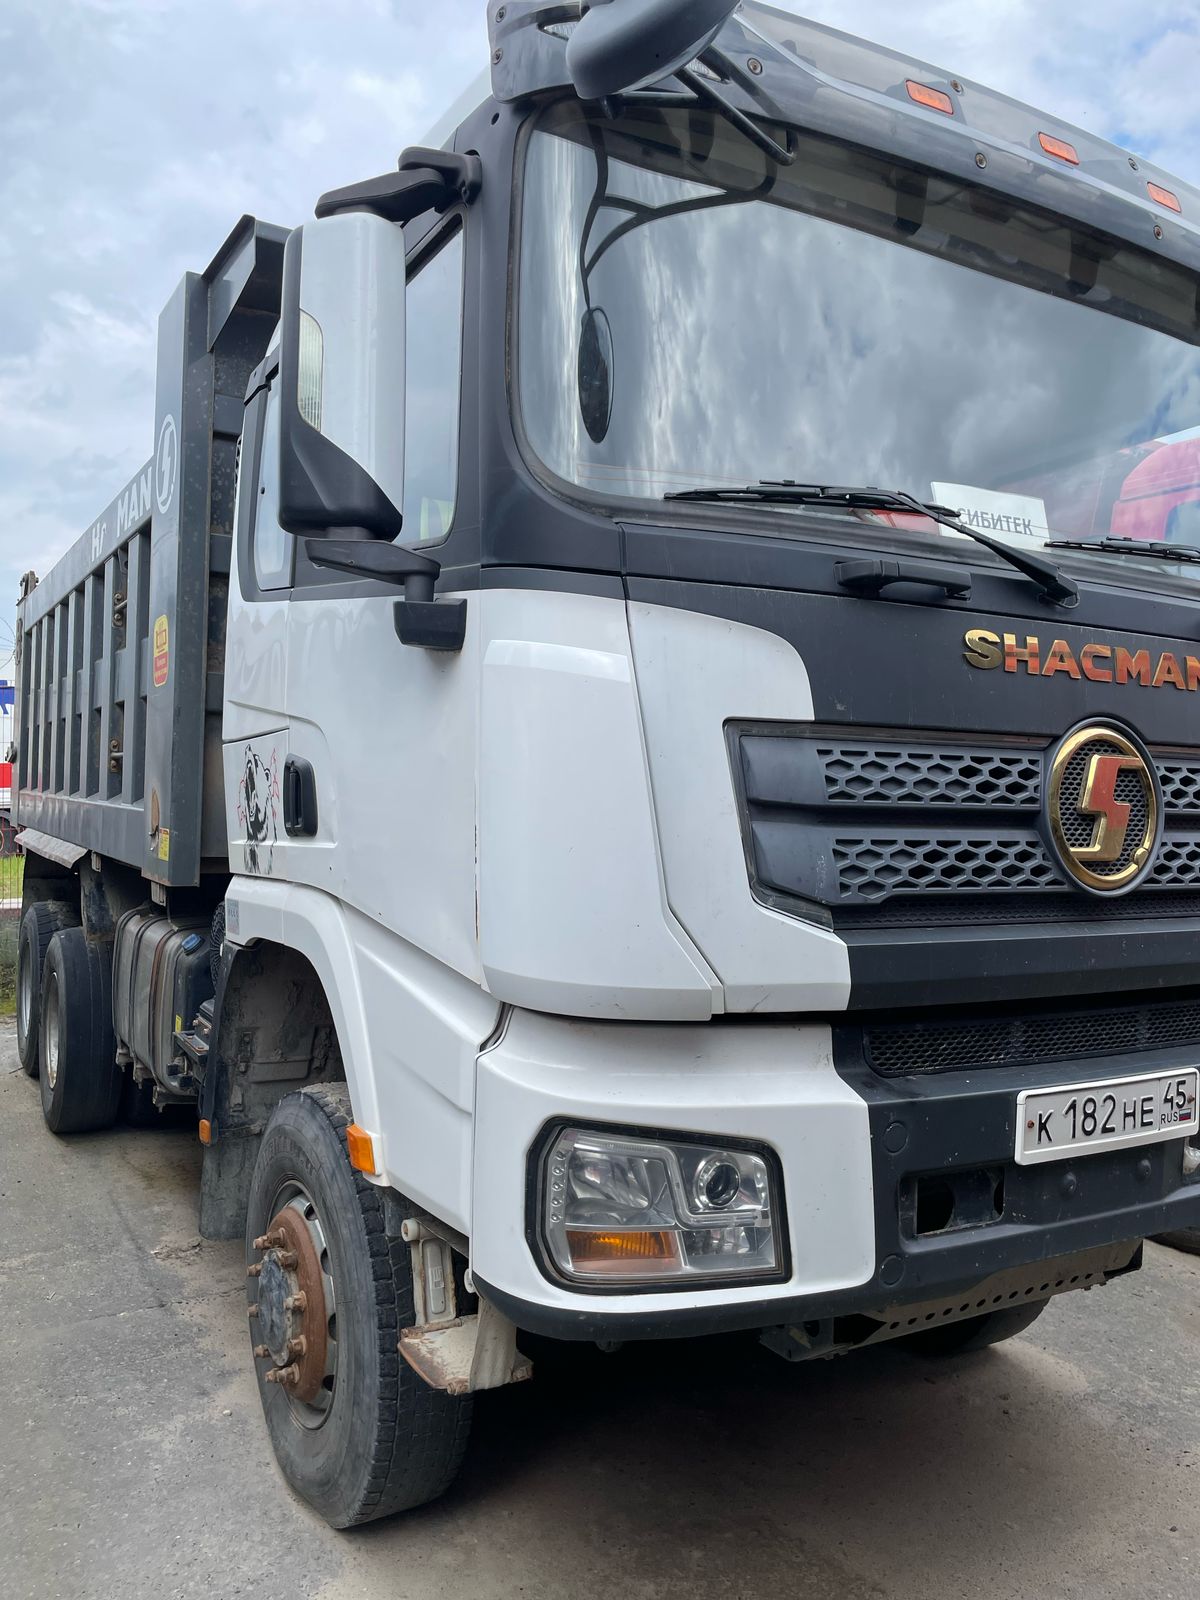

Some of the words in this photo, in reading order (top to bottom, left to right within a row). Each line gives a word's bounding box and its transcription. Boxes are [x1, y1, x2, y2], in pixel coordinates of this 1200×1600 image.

[116, 466, 153, 538] MAN
[957, 507, 1034, 536] СИБИТЕК
[1163, 1079, 1187, 1111] 45
[1160, 1111, 1179, 1125] RUS
